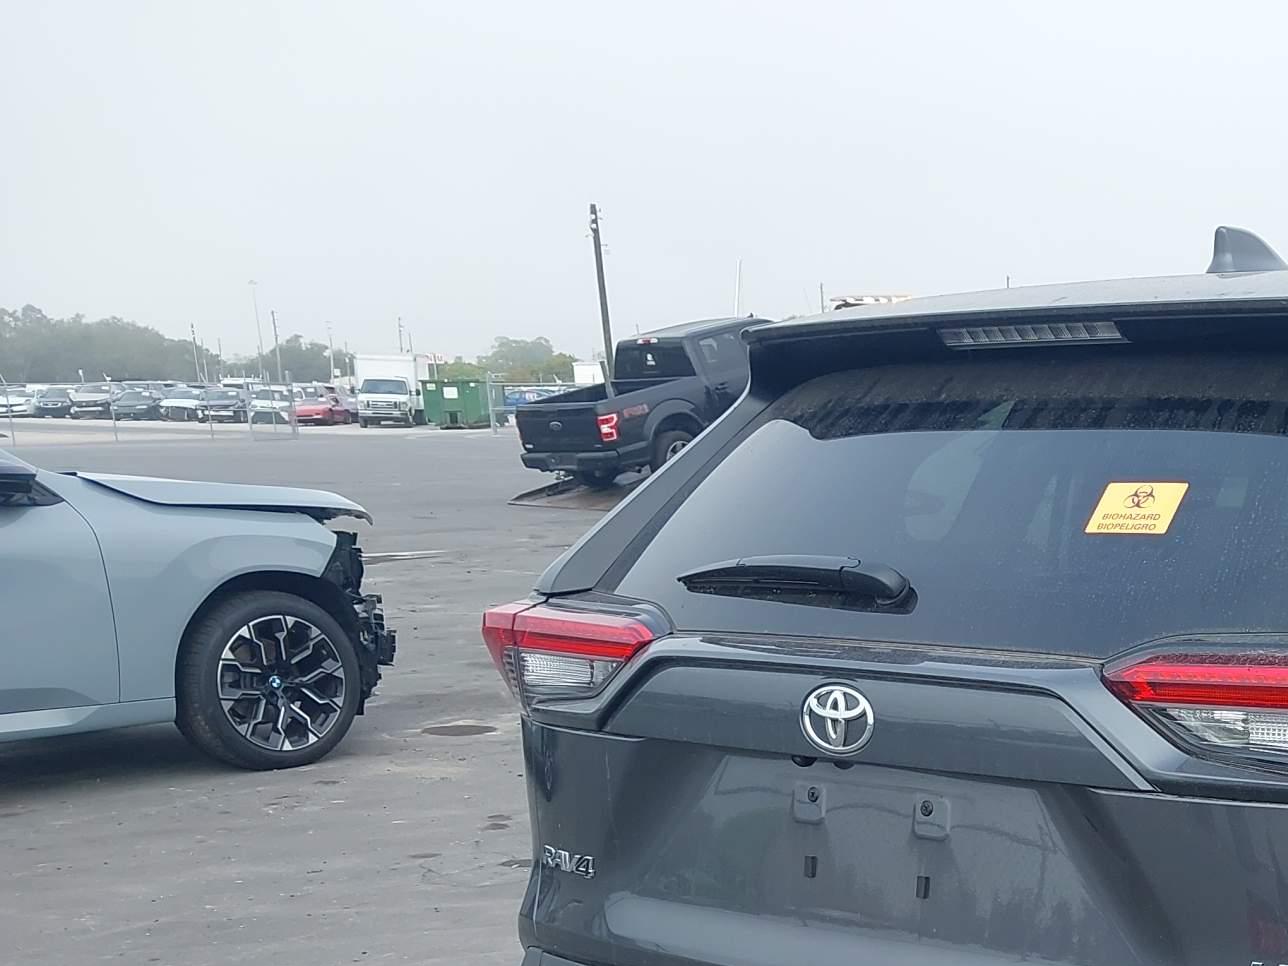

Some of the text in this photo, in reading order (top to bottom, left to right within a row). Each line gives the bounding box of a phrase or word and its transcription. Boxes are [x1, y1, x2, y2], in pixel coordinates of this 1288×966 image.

[1102, 513, 1161, 521] BIOHAZARD
[1096, 522, 1157, 531] BIOPELIGRO
[543, 844, 595, 878] RAV4
